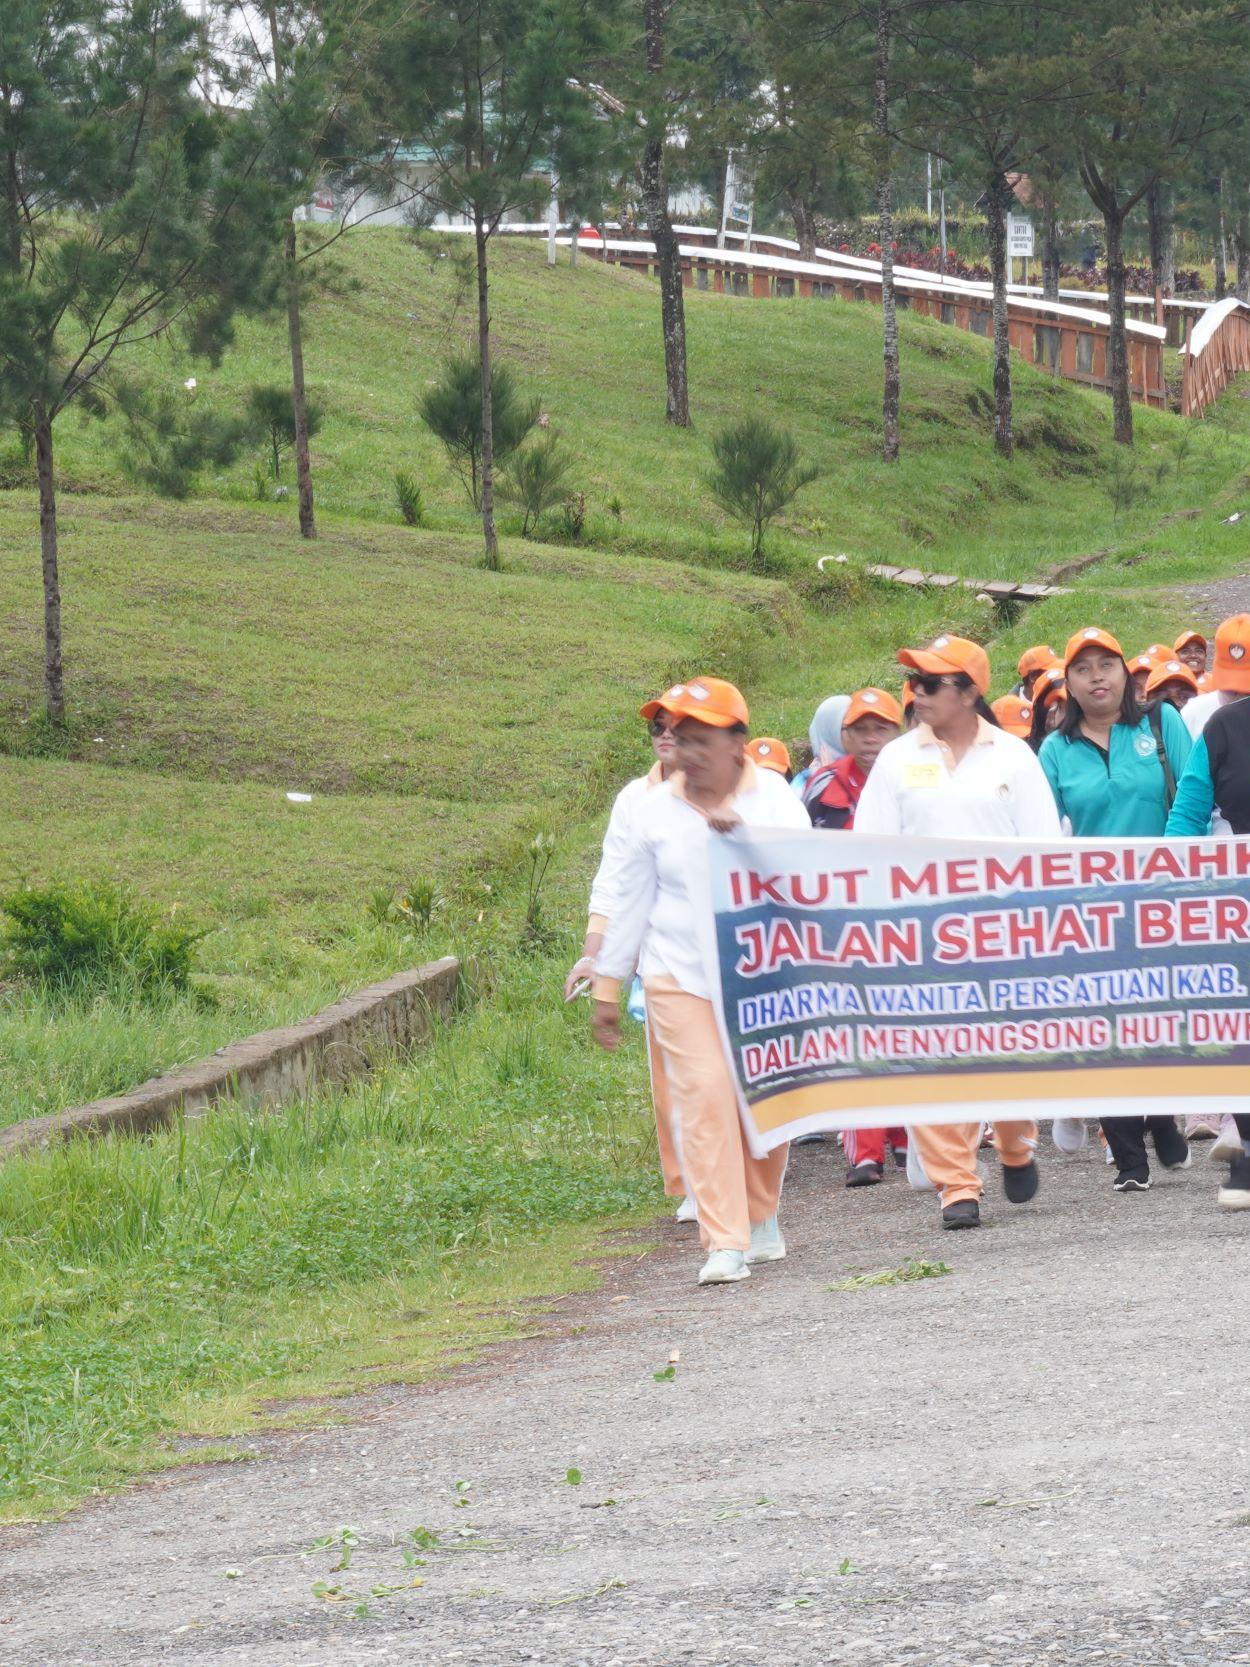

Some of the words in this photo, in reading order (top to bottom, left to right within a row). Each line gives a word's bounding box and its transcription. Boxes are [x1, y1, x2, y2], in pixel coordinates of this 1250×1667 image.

[730, 868, 869, 906] IKUT
[740, 921, 918, 974] JALAN
[937, 904, 1121, 961] SEHAT
[742, 986, 861, 1030] DHARMA
[870, 983, 984, 1012] WANITA
[994, 967, 1165, 1008] PERSATUAN
[1177, 966, 1243, 994] KAB.
[745, 1029, 848, 1079] DALAM
[862, 1018, 1107, 1056] MENYONGSONG
[1120, 1014, 1180, 1045] HUT
